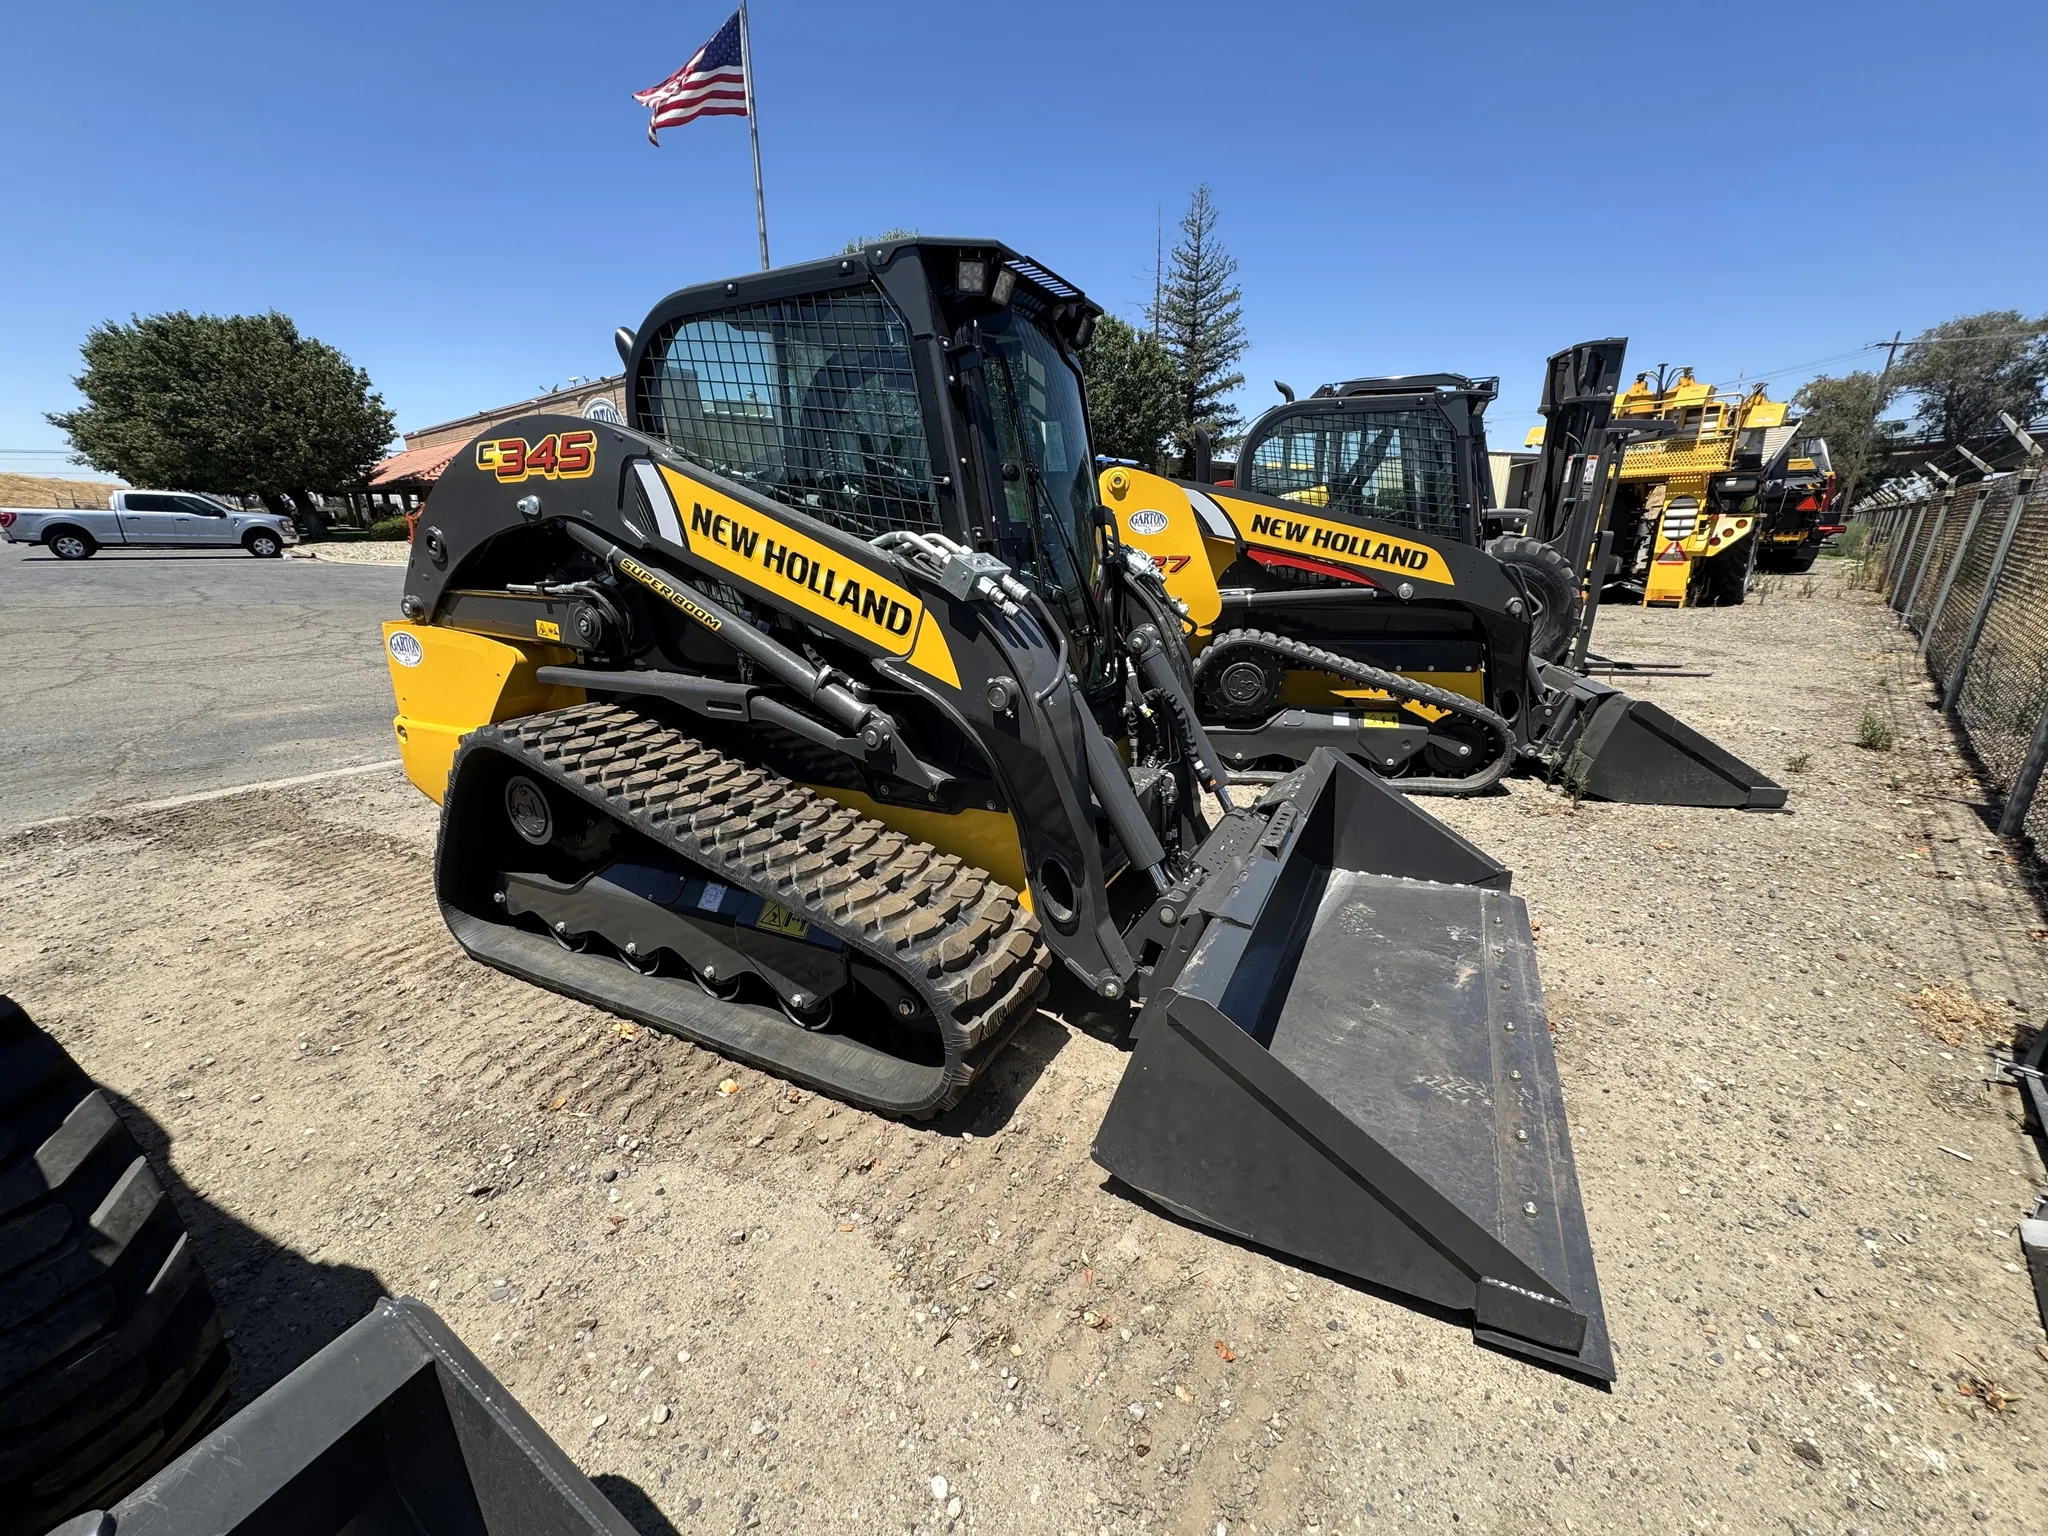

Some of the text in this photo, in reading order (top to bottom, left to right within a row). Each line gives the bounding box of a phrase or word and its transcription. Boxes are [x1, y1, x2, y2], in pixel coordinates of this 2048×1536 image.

[477, 432, 594, 477] C345
[1131, 512, 1165, 525] GARTON
[1250, 513, 1429, 571] NEW HOLLAND
[620, 559, 721, 630] SUPER BOOM
[690, 501, 913, 637] NEW HOLLAND
[391, 636, 420, 653] GARTON
